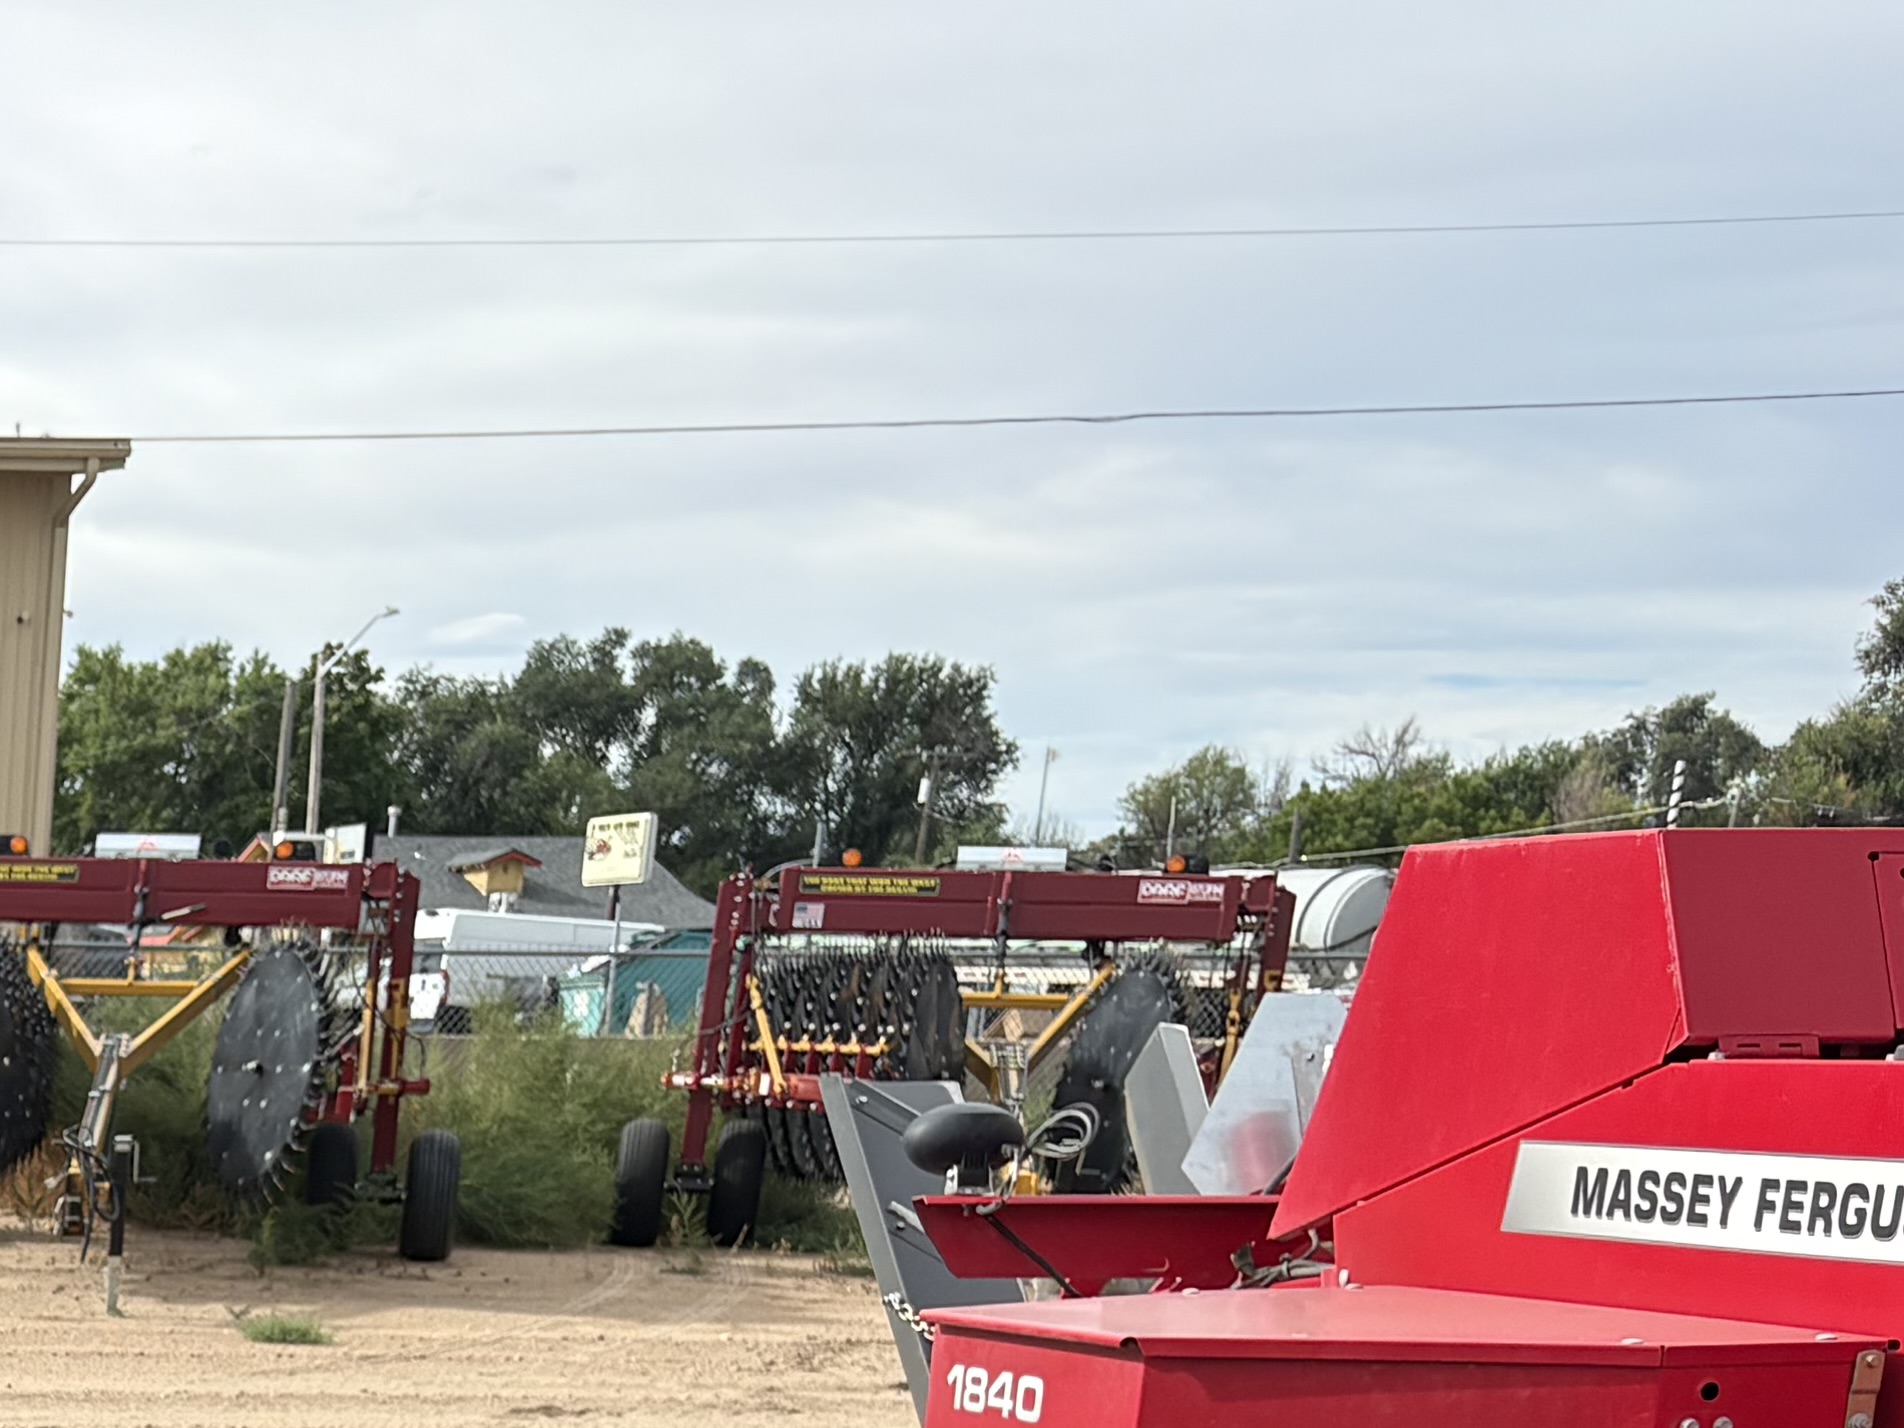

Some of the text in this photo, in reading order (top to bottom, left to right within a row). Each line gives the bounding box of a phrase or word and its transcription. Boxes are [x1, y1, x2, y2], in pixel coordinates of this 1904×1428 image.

[1570, 1165, 1904, 1242] MASSEY FERGU
[947, 1363, 1044, 1424] 1840
